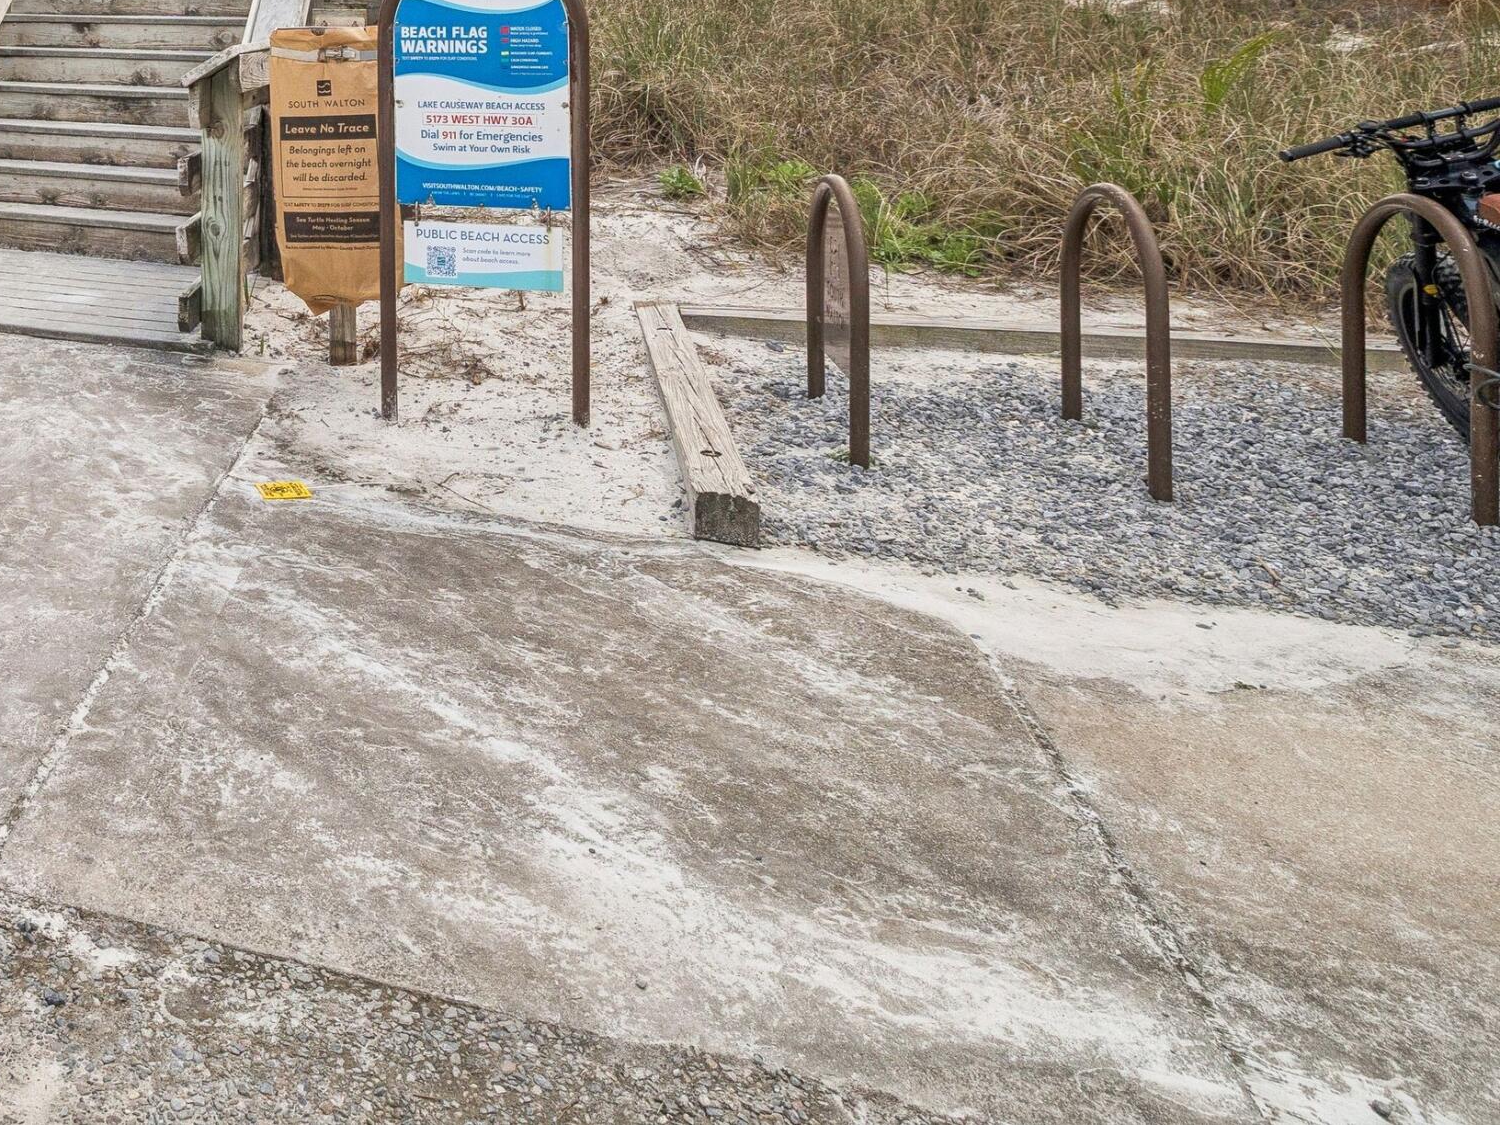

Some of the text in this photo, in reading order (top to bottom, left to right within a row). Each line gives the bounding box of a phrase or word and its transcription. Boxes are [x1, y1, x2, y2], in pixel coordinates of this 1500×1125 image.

[401, 26, 487, 38] BEACH FLAG
[401, 40, 488, 53] WARNINGS
[288, 99, 365, 108] SOUTH WALTON
[440, 101, 484, 109] CAUSEWAY
[485, 102, 512, 110] BEACH
[515, 102, 545, 111] ACCESS
[426, 115, 533, 125] 5173 WEST HWY 30A
[285, 123, 369, 134] Leave No Trace
[420, 129, 543, 144] Dial 911 for Emergencies
[289, 145, 335, 156] Belongings
[338, 145, 352, 155] left
[432, 143, 531, 154] Swim at Your Own Risk
[286, 158, 371, 169] the beach overnight
[293, 172, 368, 182] will be discarded.
[416, 228, 550, 245] PUBLIC BEACH ACCESS
